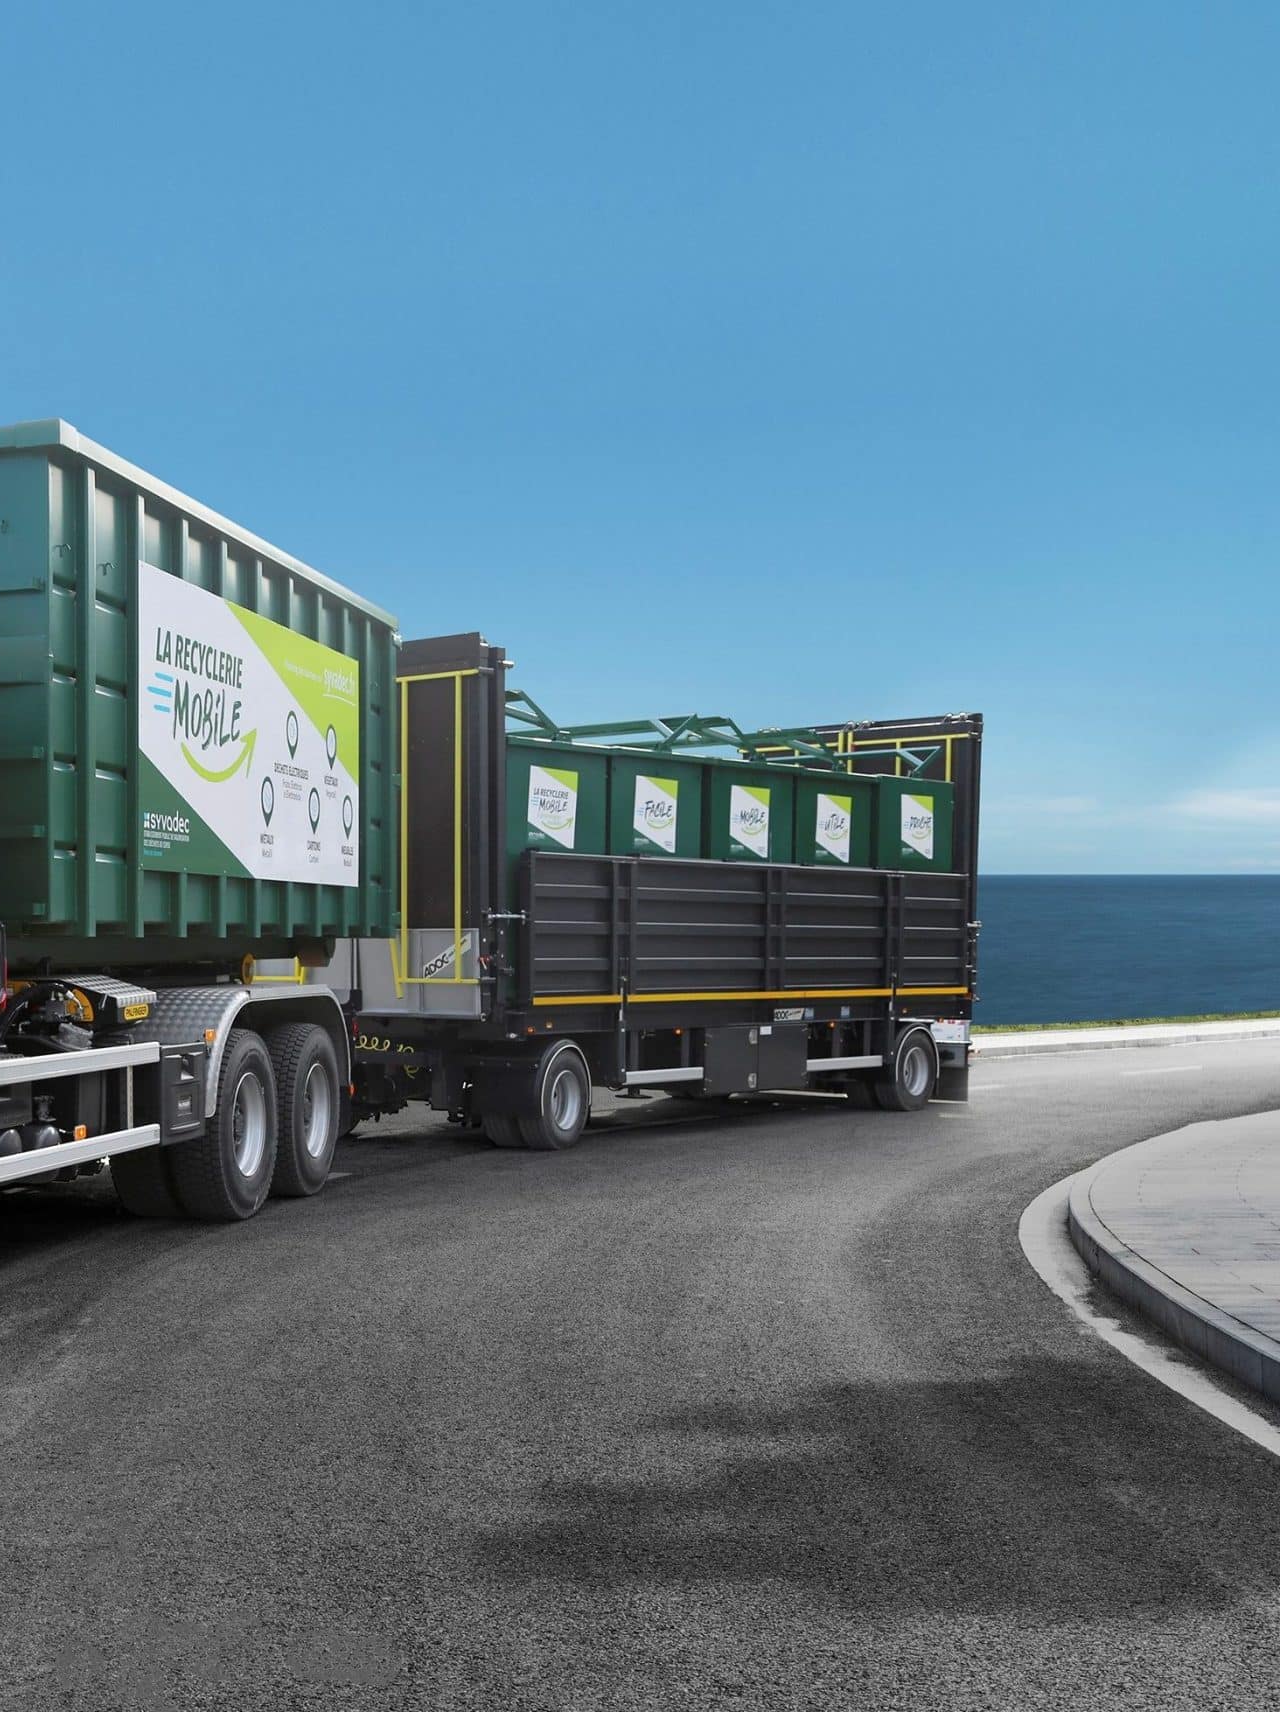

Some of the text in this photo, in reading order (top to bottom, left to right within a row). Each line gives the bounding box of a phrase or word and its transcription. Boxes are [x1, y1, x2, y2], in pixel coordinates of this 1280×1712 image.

[156, 627, 171, 665] LA
[175, 634, 243, 689] RECYCLERIE
[534, 787, 569, 799] LA RECYCLERIE
[150, 810, 189, 834] syvadec
